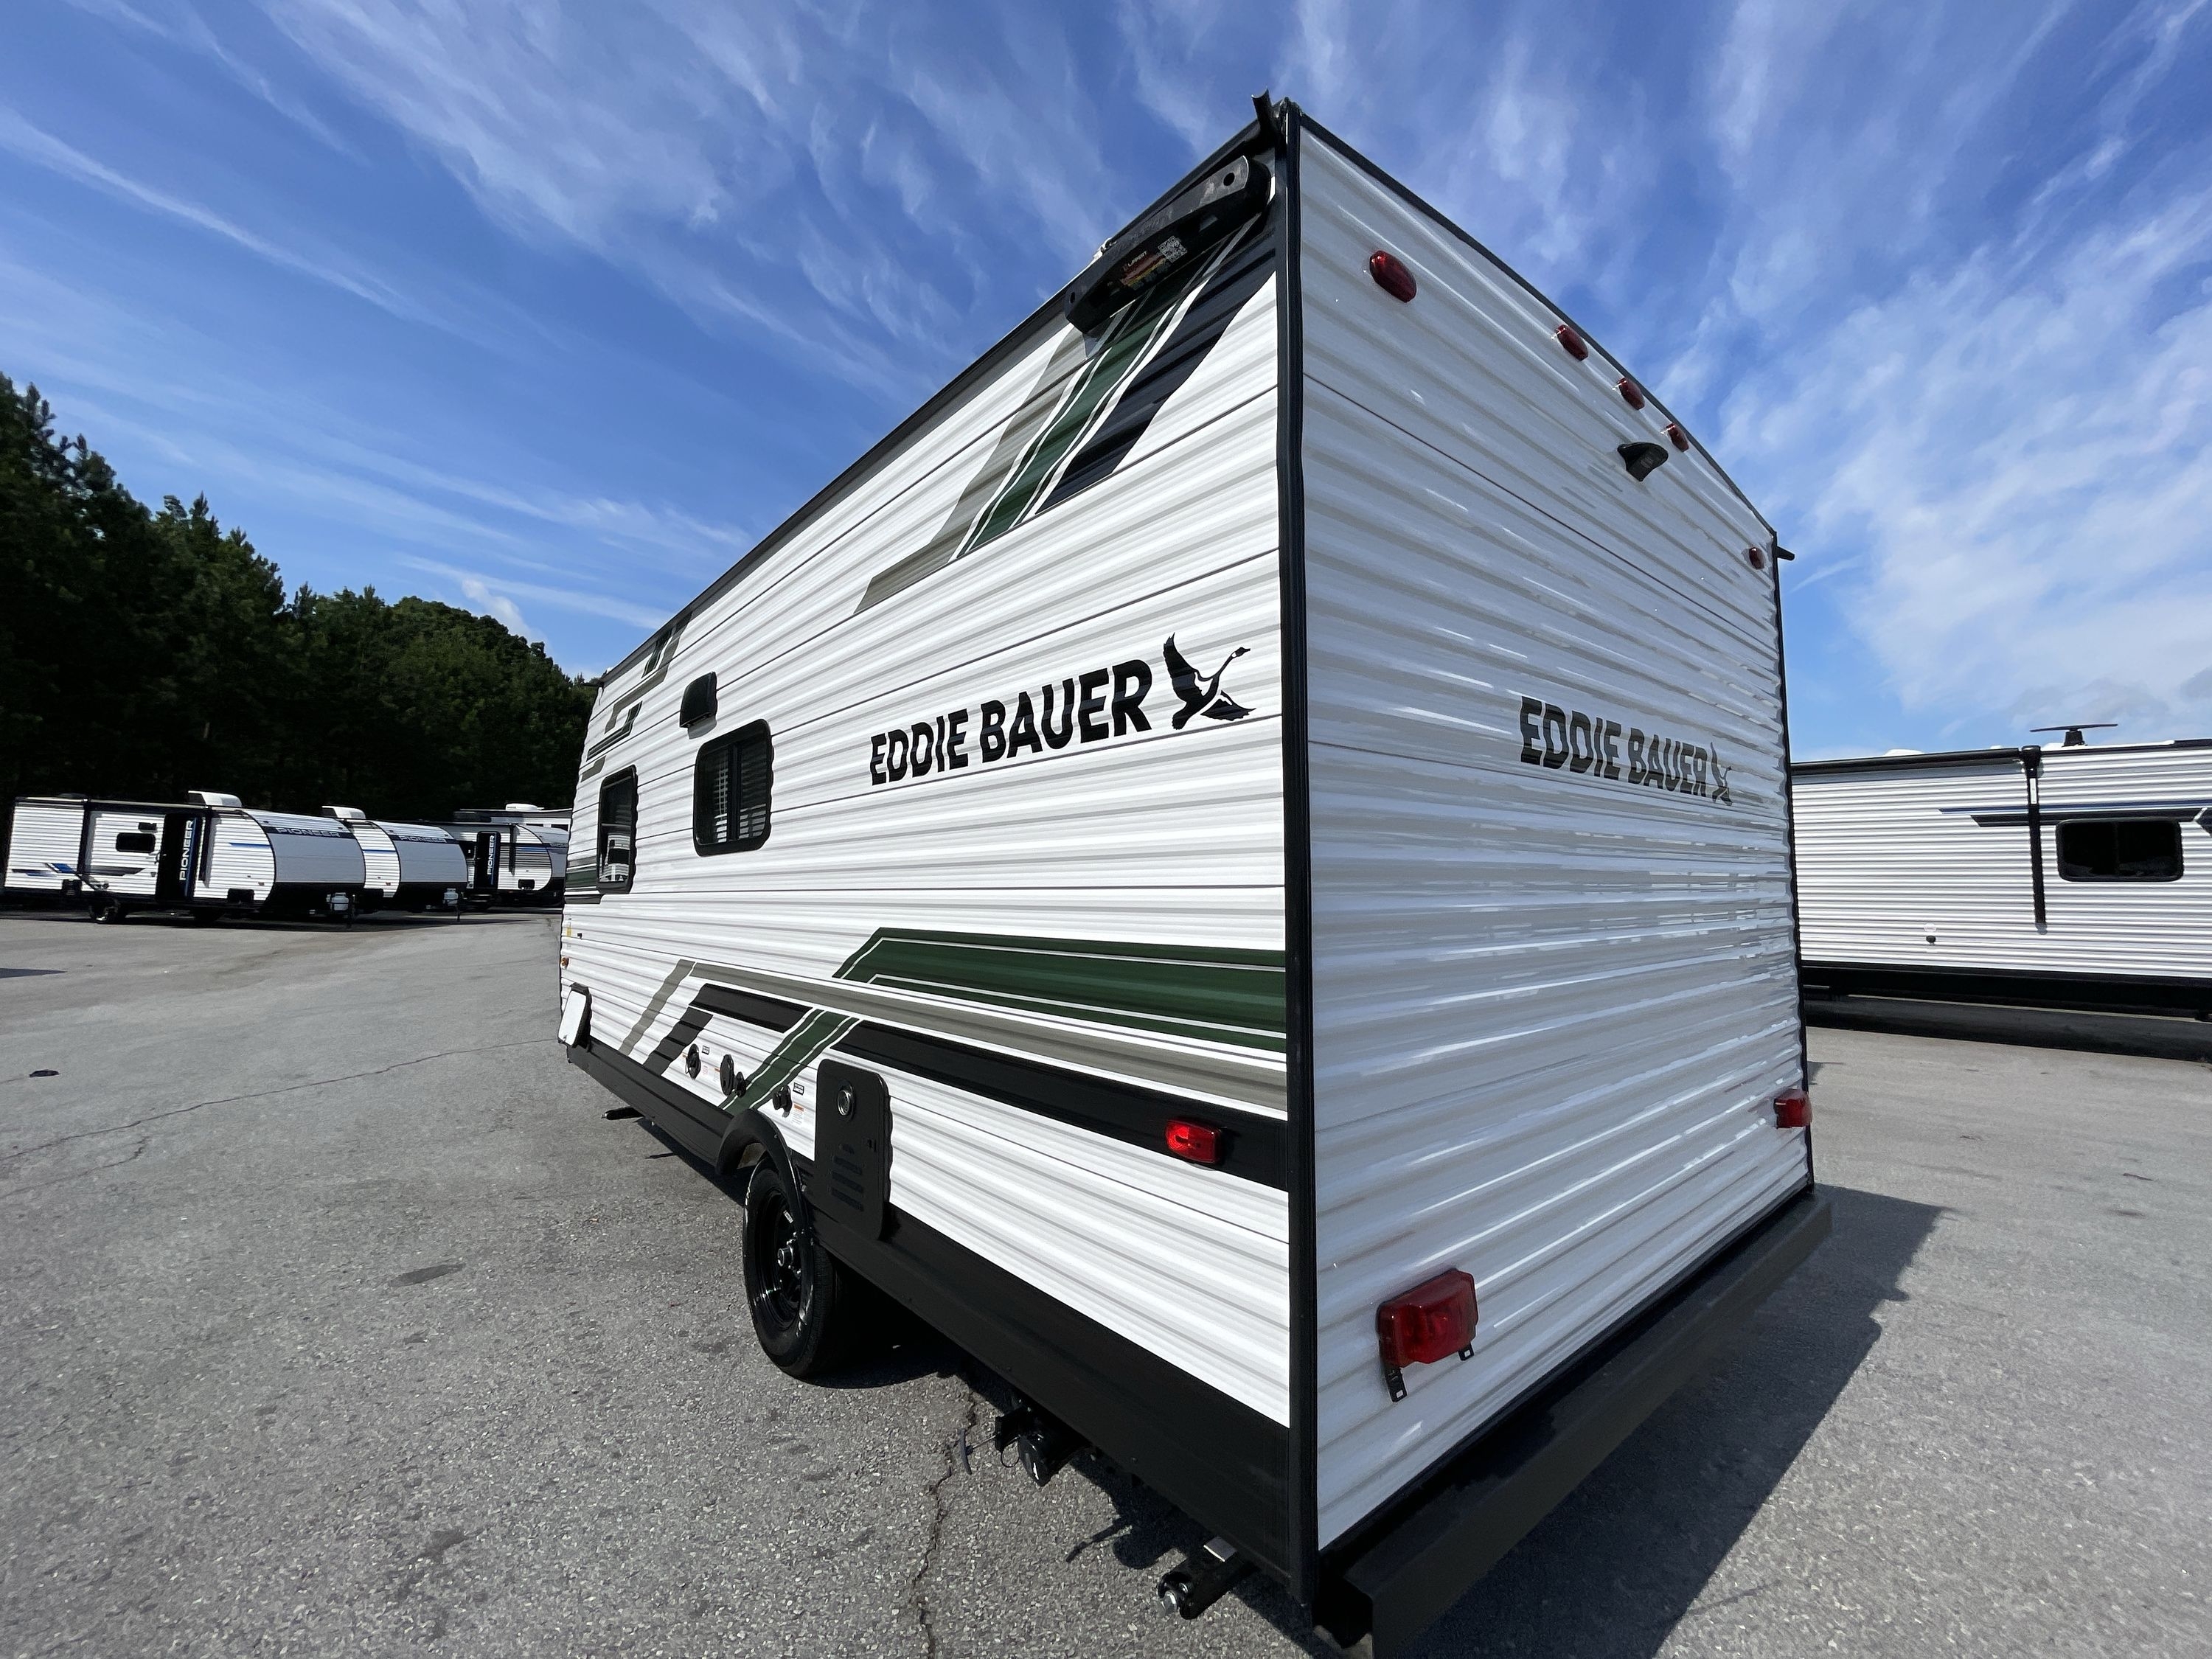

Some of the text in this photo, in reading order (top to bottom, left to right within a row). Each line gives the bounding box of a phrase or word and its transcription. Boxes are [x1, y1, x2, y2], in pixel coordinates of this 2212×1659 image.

[870, 658, 1152, 786] EDDIE BAUER
[1520, 695, 1708, 798] EDDIE BAUER
[178, 820, 194, 880] PIONEER
[276, 827, 341, 838] PIONEER
[487, 835, 495, 875] PIONEER
